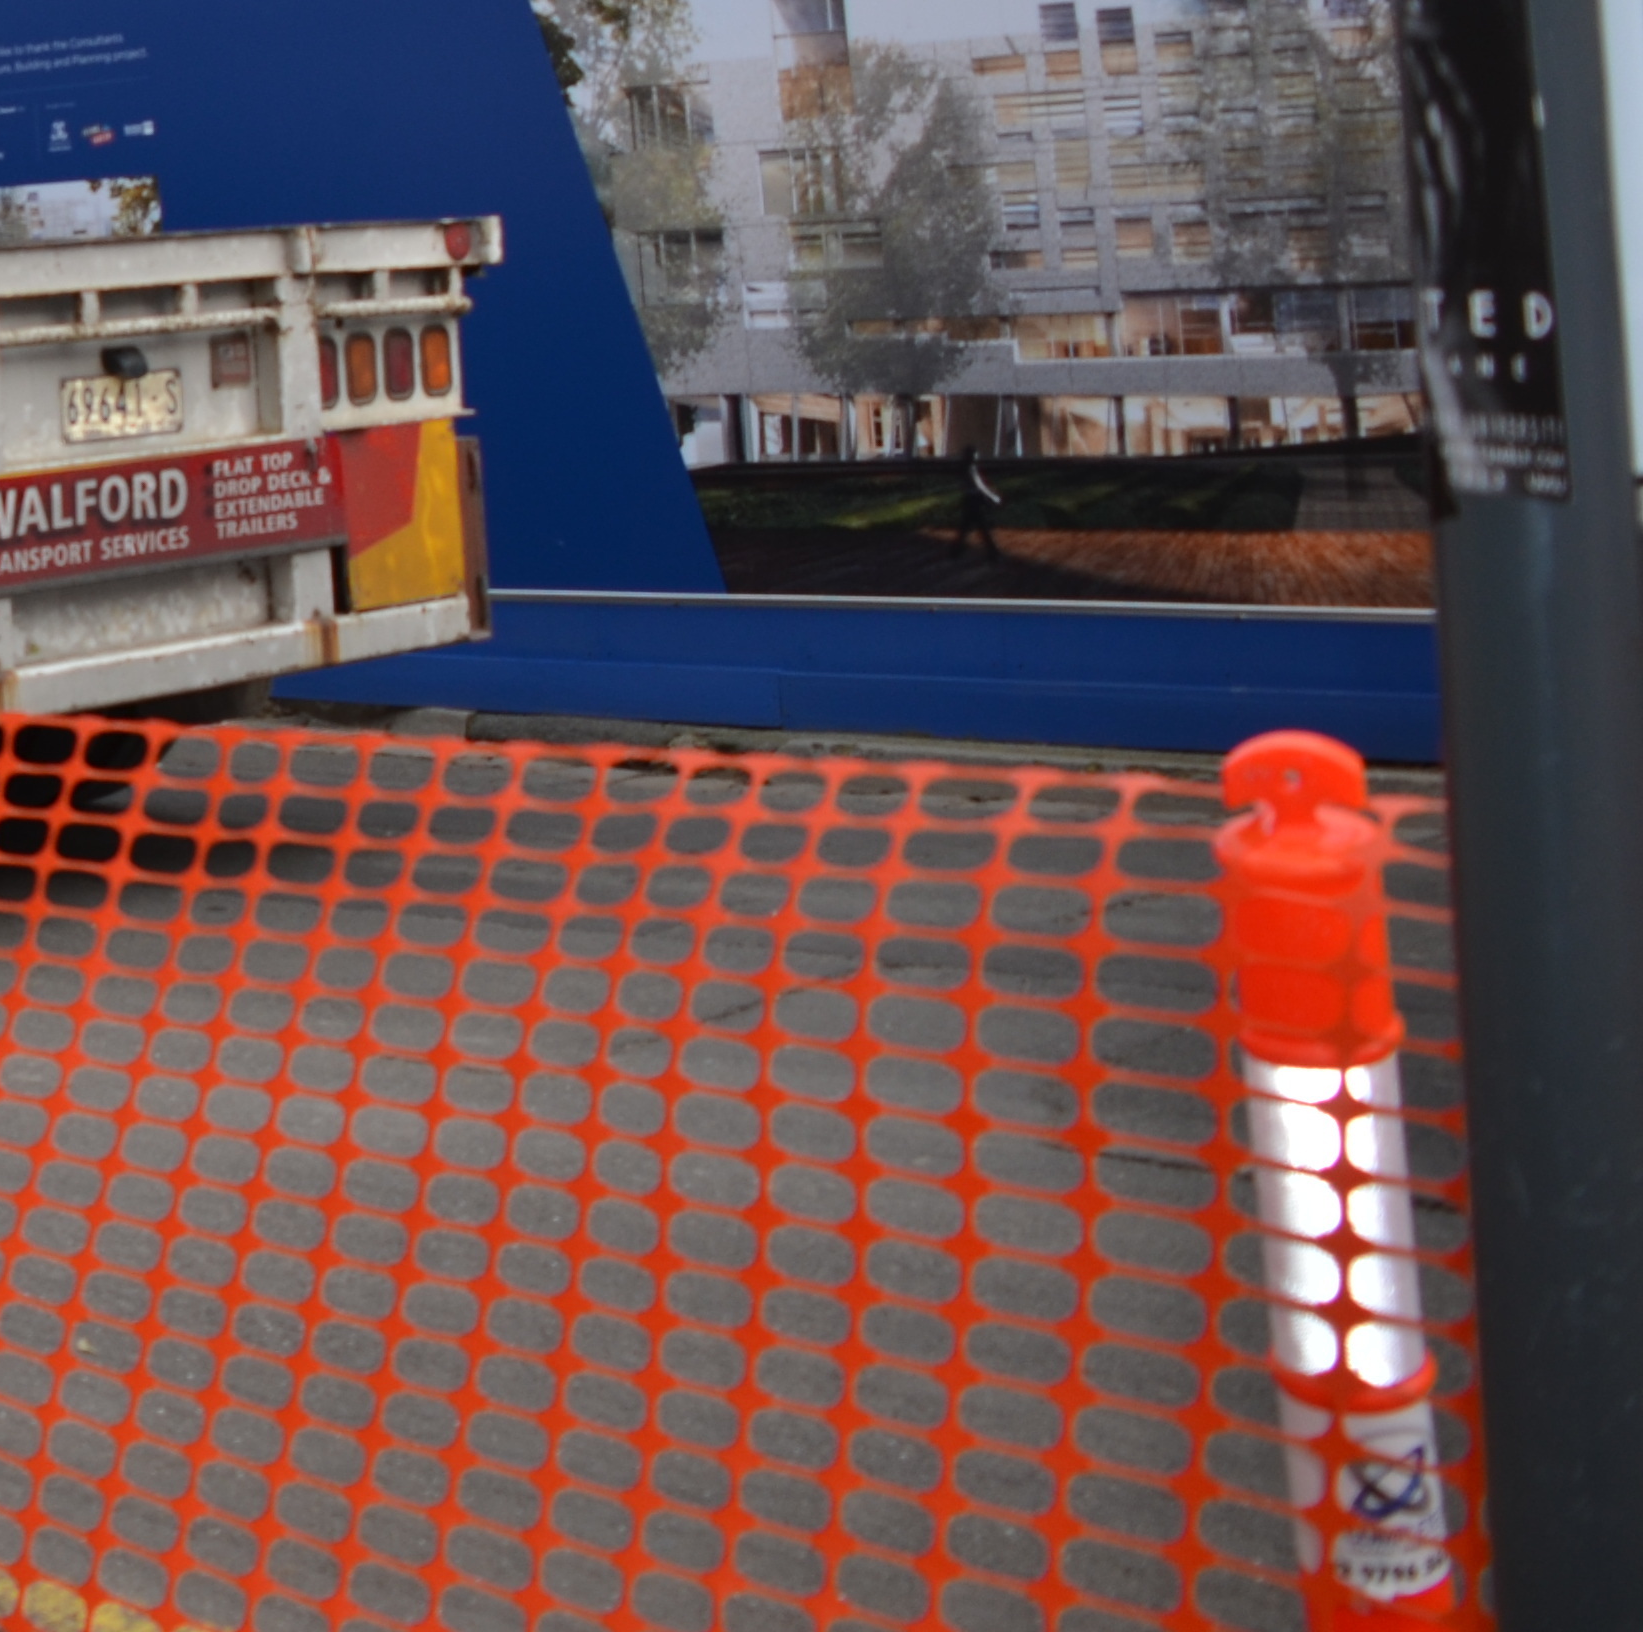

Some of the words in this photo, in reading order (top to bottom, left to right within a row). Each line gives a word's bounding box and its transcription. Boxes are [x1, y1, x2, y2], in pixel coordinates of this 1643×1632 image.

[25, 40, 51, 54] thank
[69, 32, 124, 49] Consultants
[14, 58, 52, 74] Building
[53, 55, 71, 68] and
[72, 51, 113, 67] Planning
[212, 455, 256, 477] FLAT
[260, 451, 294, 472] TOP
[213, 478, 263, 499] DROP
[267, 470, 312, 492] DECK
[317, 466, 333, 485] &
[215, 488, 325, 519] EXTENDABLE
[216, 511, 299, 540] TRAILERS
[100, 525, 191, 561] SERVICES
